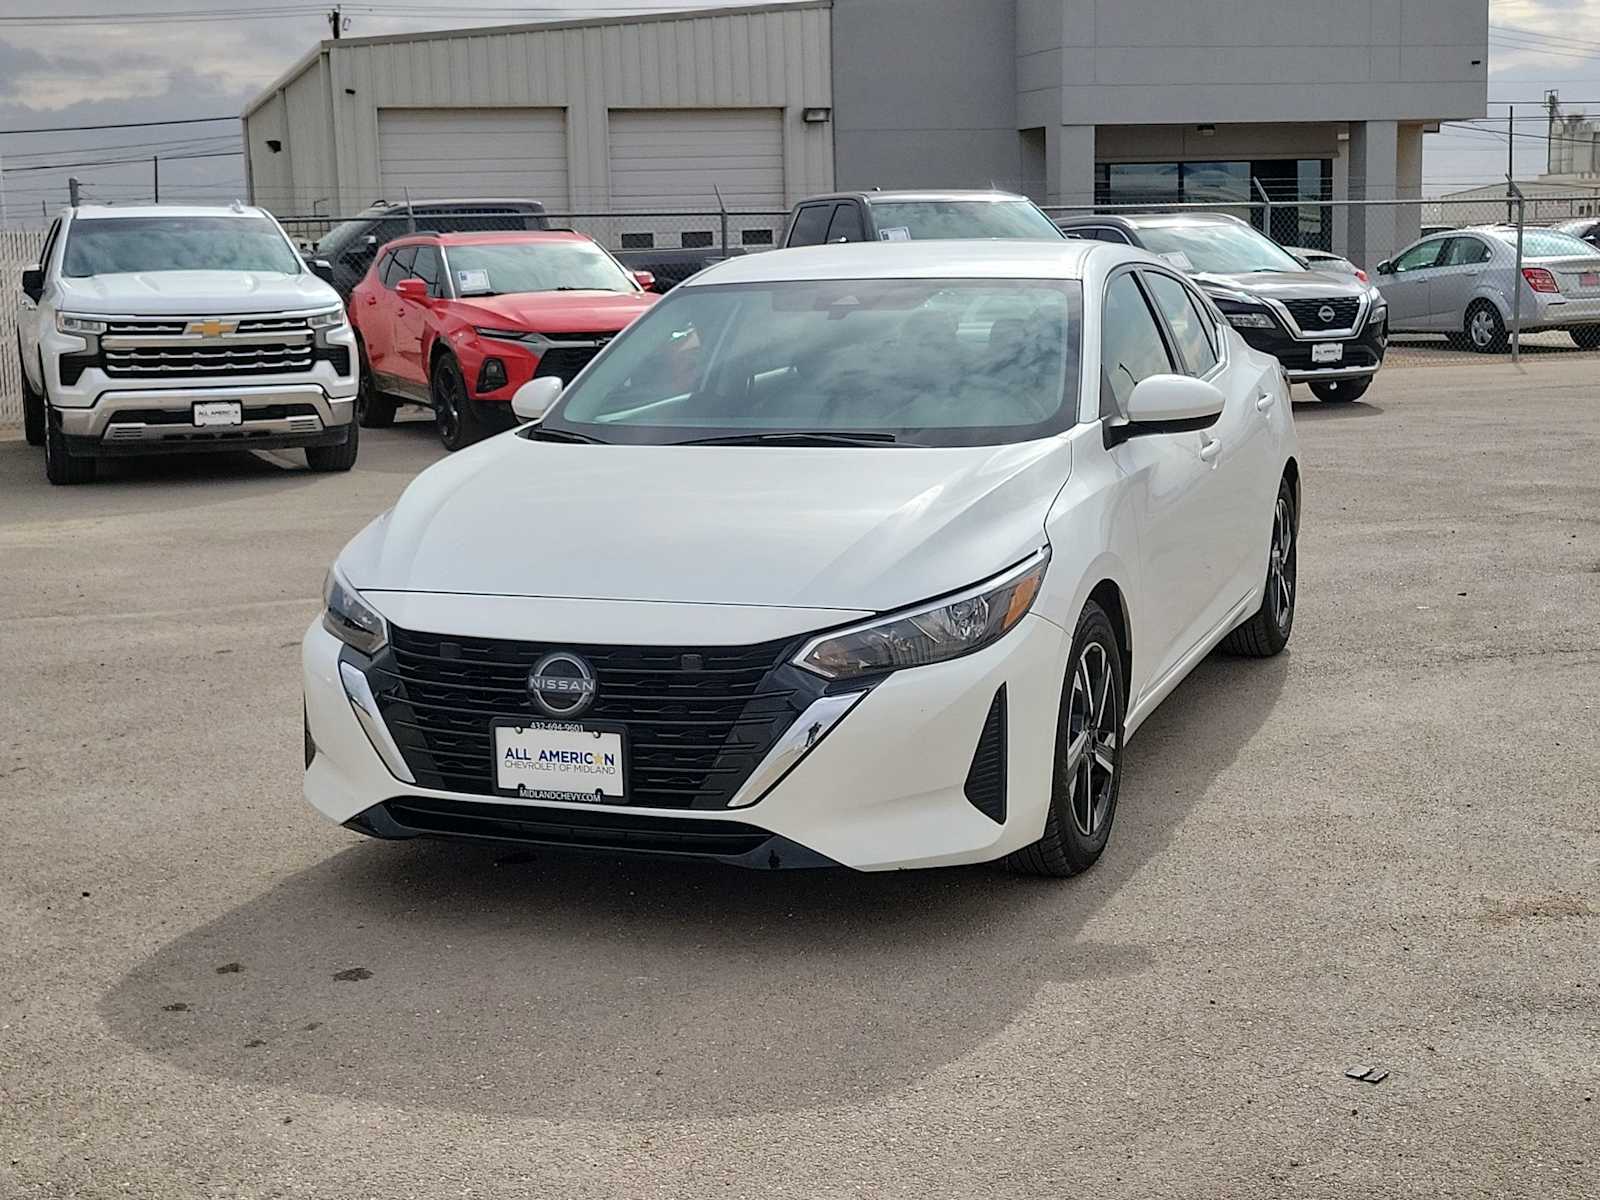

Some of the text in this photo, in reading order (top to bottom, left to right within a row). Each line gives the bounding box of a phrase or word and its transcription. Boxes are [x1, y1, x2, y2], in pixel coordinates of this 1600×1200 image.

[530, 679, 593, 691] NISSAN
[505, 747, 531, 761] ALL
[504, 760, 616, 775] CHEVROLET OF MIDLAND
[520, 789, 600, 802] MIDLANDCHEVY.COM
